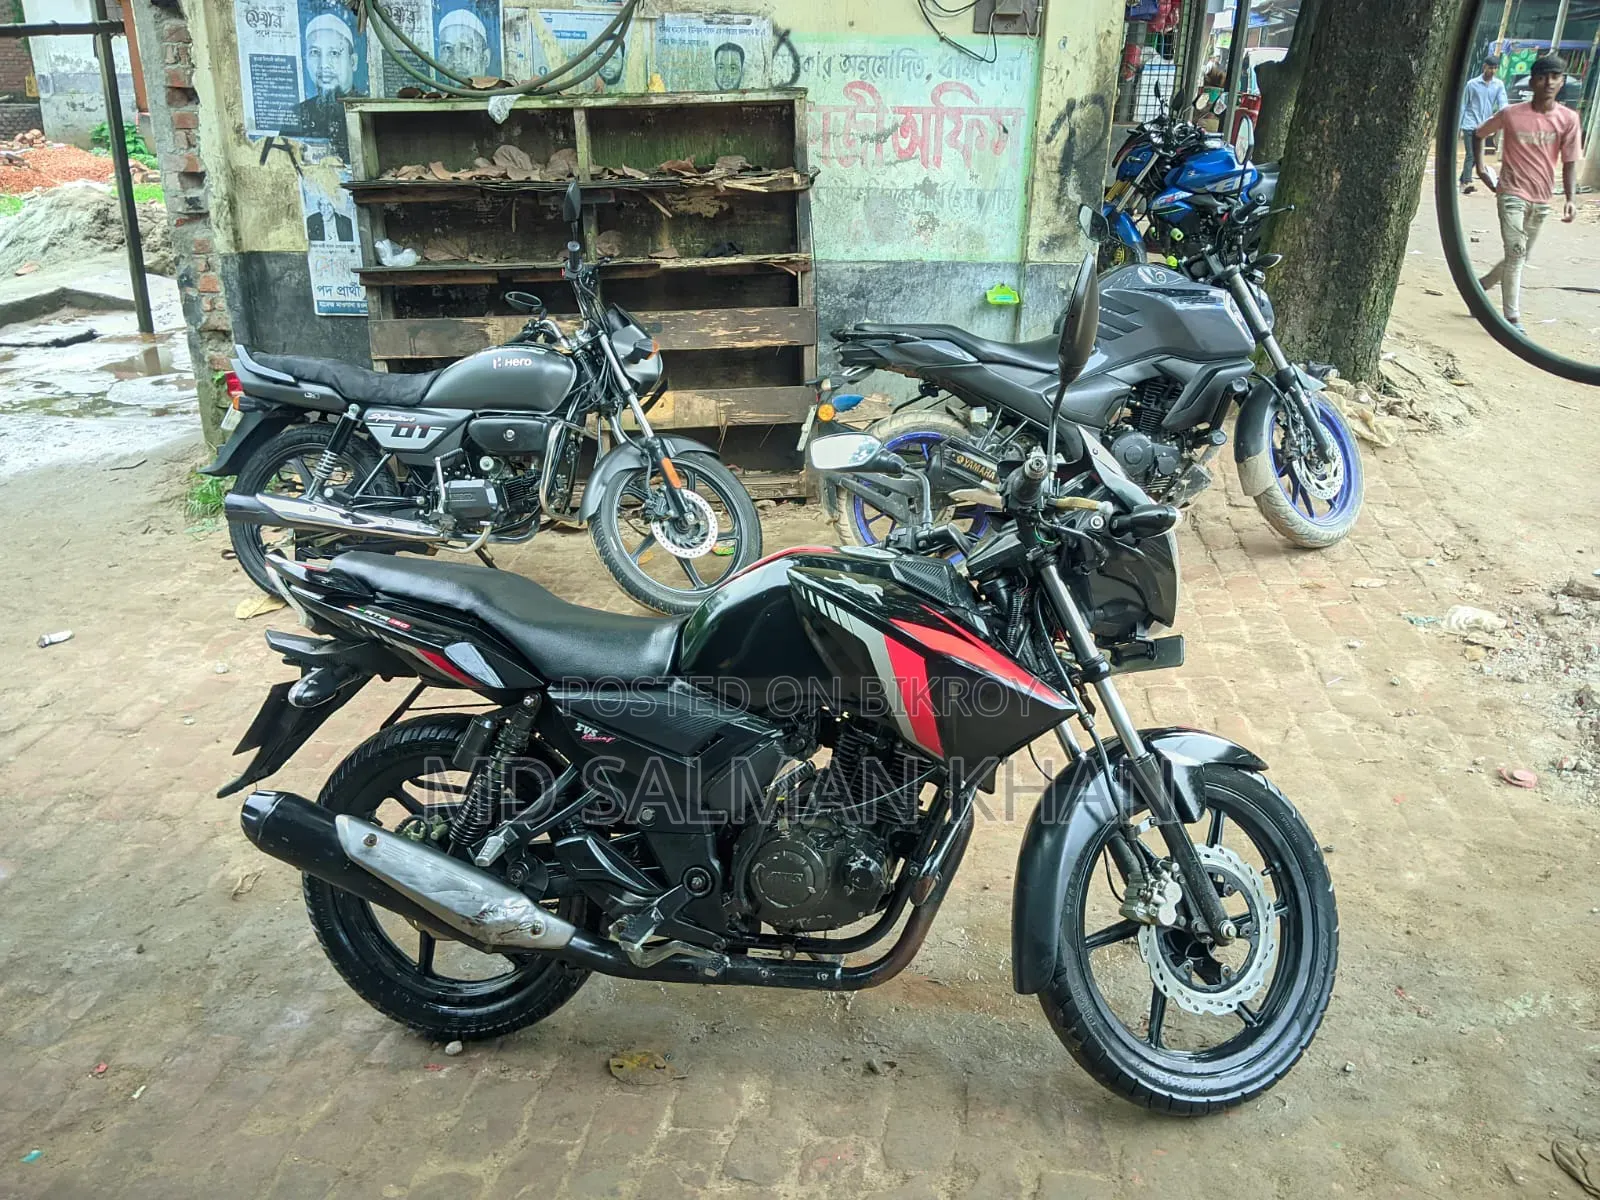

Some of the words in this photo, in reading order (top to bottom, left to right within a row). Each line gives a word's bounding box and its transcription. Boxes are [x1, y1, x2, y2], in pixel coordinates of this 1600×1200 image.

[891, 80, 1026, 169] অফিস
[504, 358, 533, 367] Hero
[965, 457, 996, 480] YAMAHA
[574, 722, 600, 737] TVS
